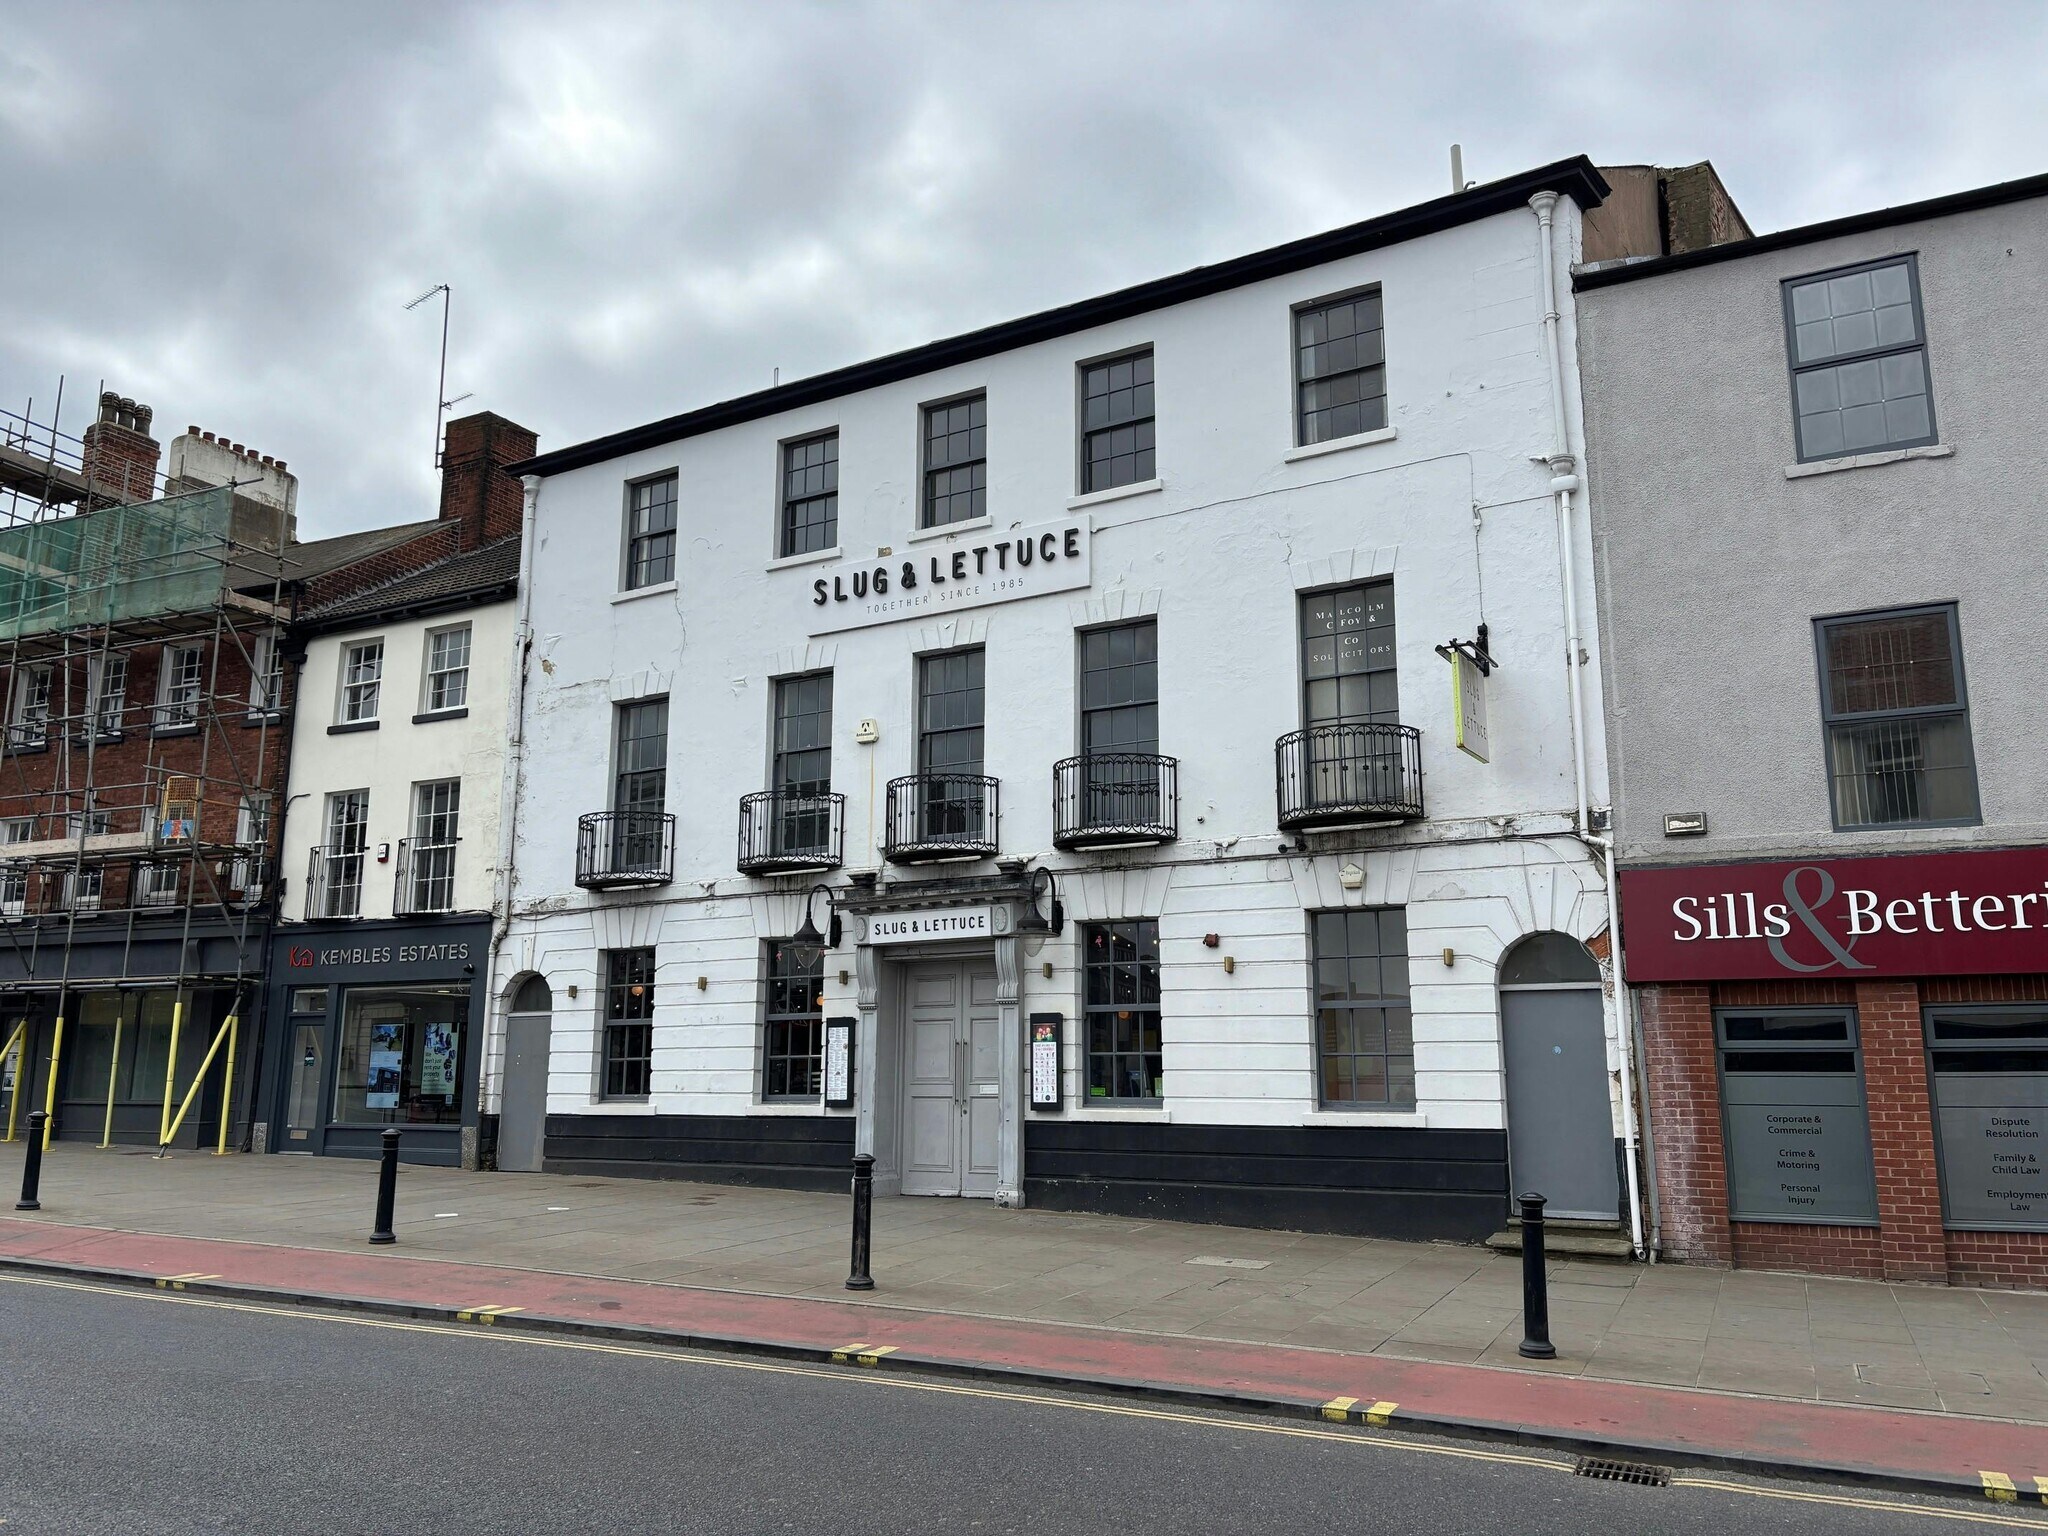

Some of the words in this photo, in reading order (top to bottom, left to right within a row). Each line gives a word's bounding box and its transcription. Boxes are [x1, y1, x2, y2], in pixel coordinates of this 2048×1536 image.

[813, 567, 888, 605] SLUG
[901, 561, 917, 589] &
[931, 527, 1080, 583] LETTUCE
[867, 595, 928, 613] TOGETHER
[941, 586, 980, 600] SINCE
[992, 578, 1024, 591] 1985
[1340, 617, 1361, 627] FOY
[1368, 614, 1376, 622] &
[1672, 892, 1792, 941] Sills
[1767, 866, 1877, 972] &
[874, 921, 907, 935] SLUG
[912, 920, 919, 932] &
[924, 915, 984, 932] LETTUCE
[320, 946, 391, 965] KEMBLES
[399, 943, 469, 962] ESTATES
[1766, 1115, 1812, 1124] Corporate
[1991, 1117, 2030, 1127] Dispute
[1768, 1126, 1822, 1134] Commercial
[1986, 1130, 2039, 1138] Resolution
[1779, 1149, 1806, 1157] Crime
[1993, 1154, 2026, 1163] Family
[2029, 1154, 2036, 1162] &
[1777, 1161, 1820, 1171] Motoring
[1992, 1166, 2018, 1174] Child
[2020, 1166, 2041, 1174] Law
[1781, 1184, 1820, 1192] Personal
[1987, 1190, 2048, 1200] Employmen
[1788, 1196, 1815, 1205] Injury
[2010, 1202, 2030, 1211] Law
